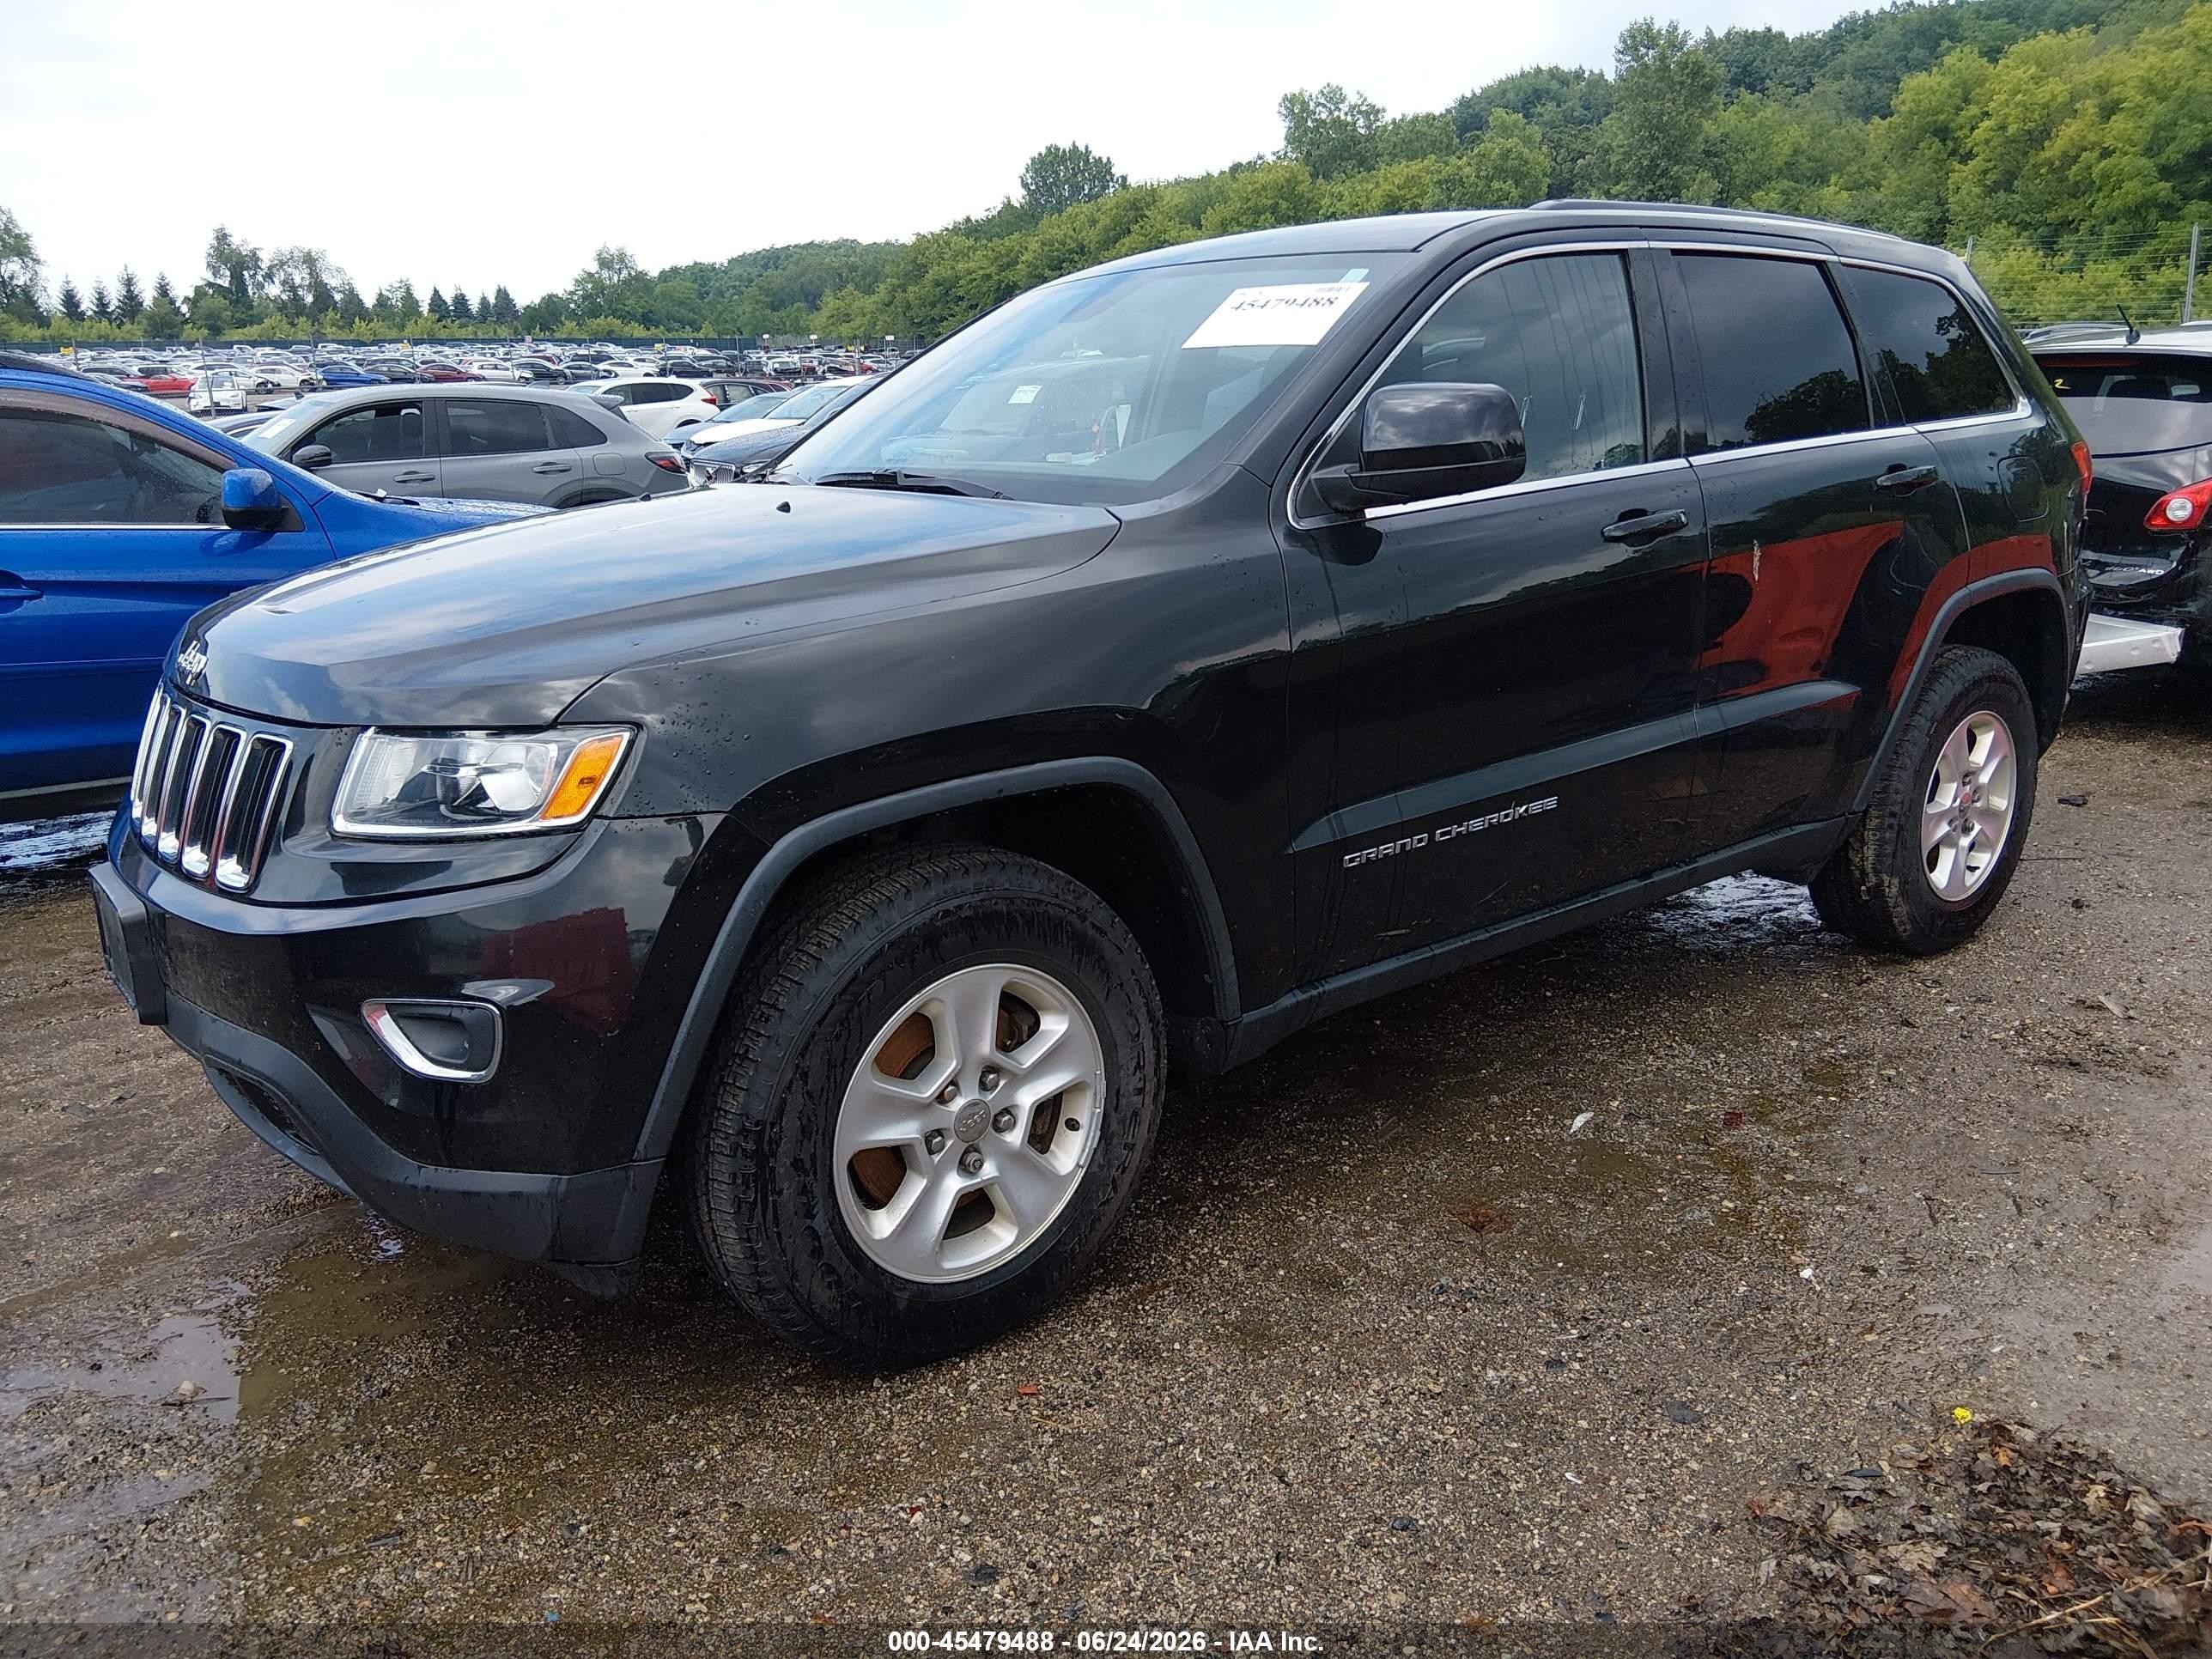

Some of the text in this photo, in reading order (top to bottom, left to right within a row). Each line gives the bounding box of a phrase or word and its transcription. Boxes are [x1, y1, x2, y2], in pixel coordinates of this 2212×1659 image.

[1231, 296, 1339, 311] 45479488
[1342, 796, 1559, 869] GRAND CHEROKEE
